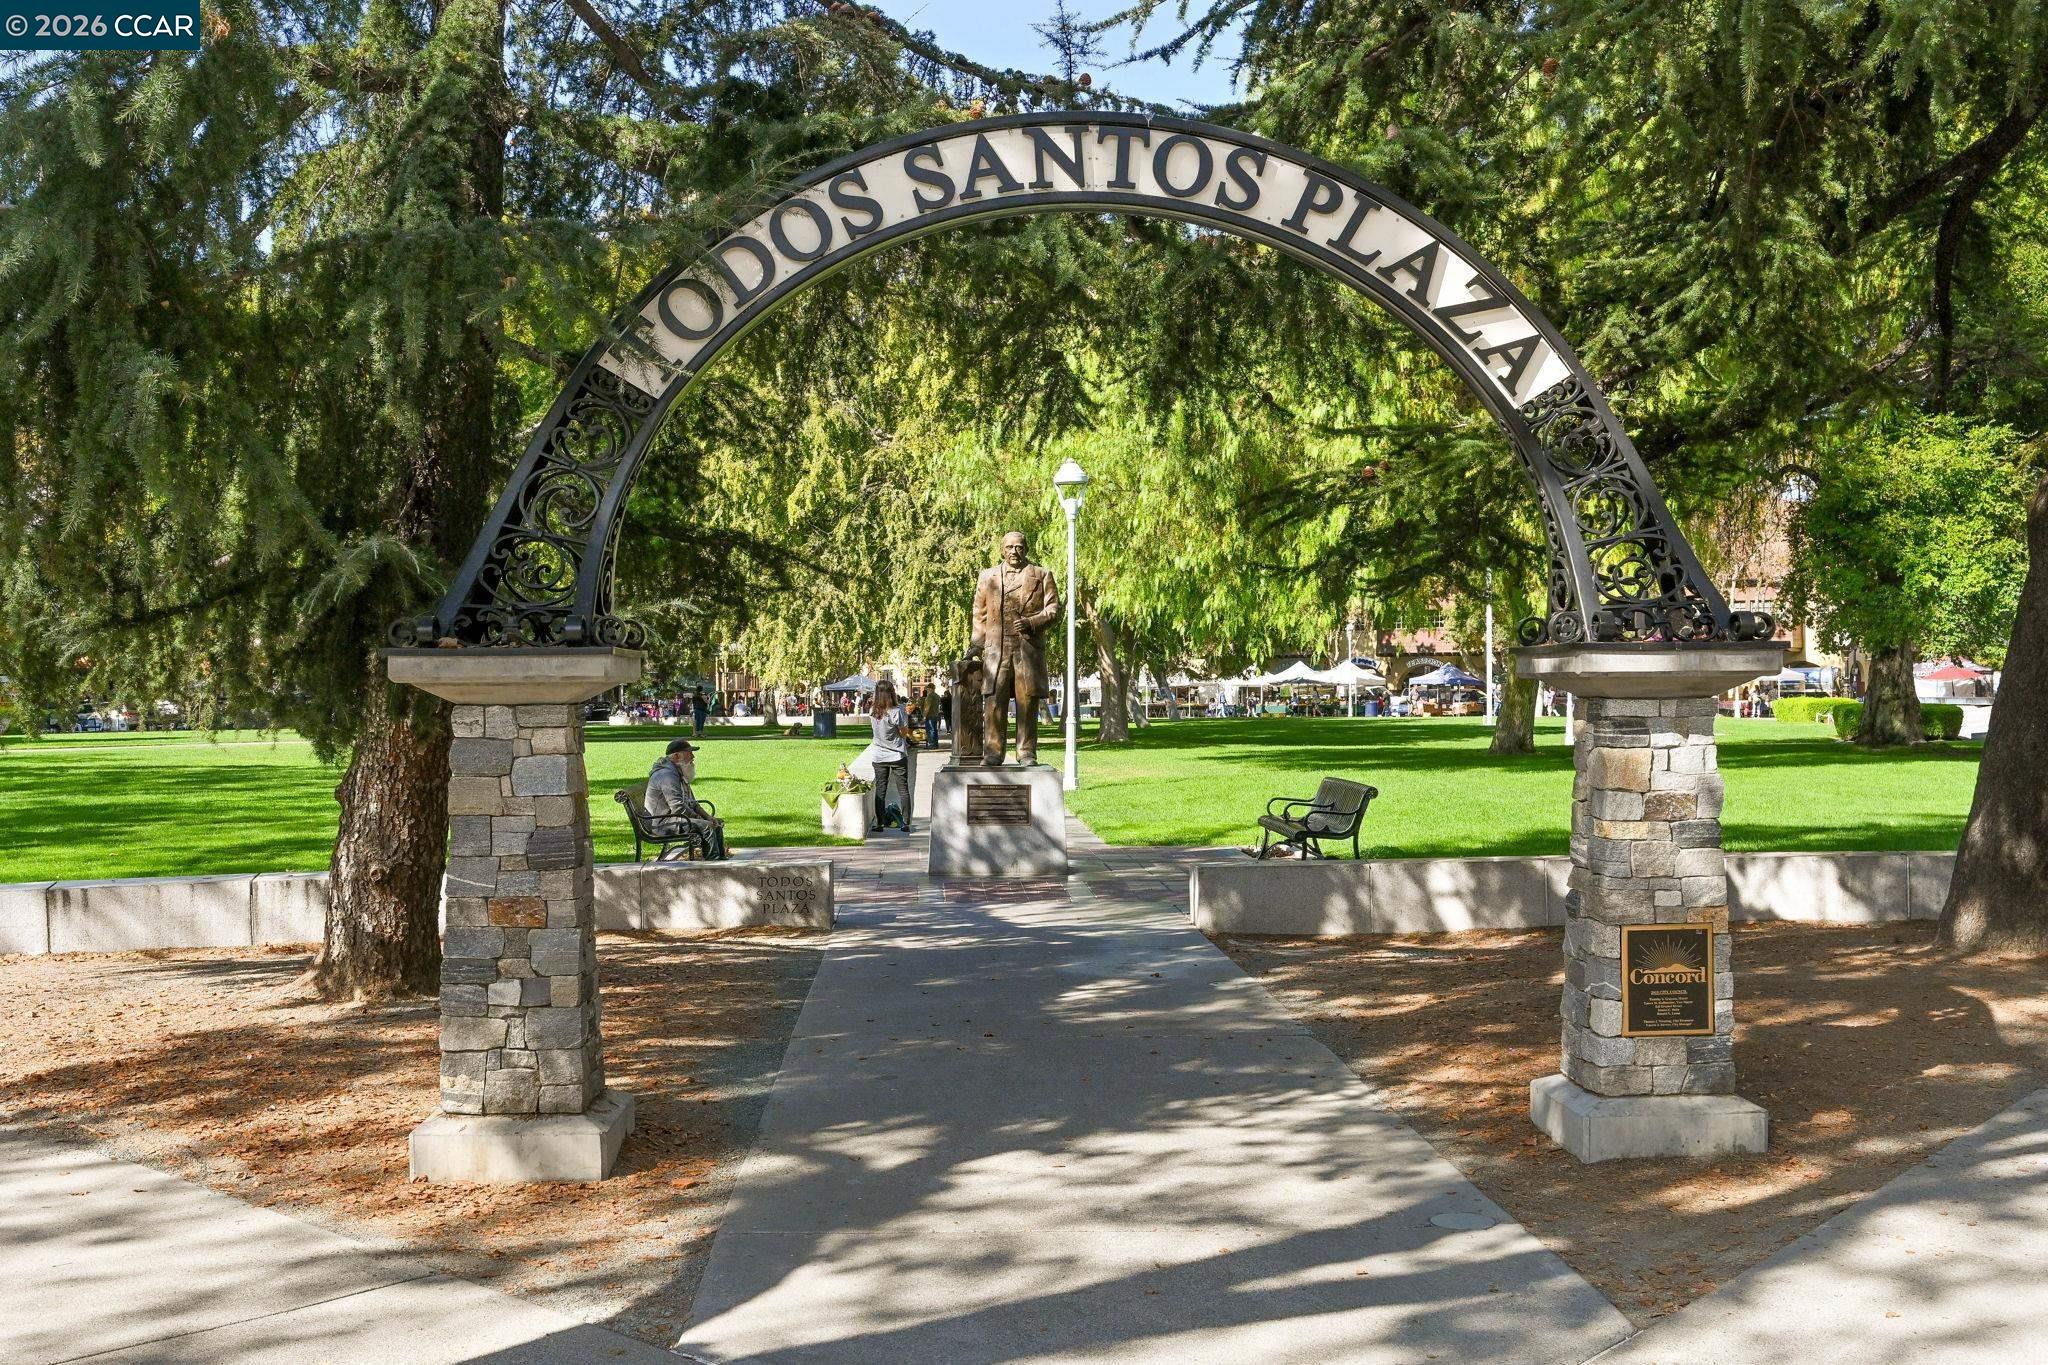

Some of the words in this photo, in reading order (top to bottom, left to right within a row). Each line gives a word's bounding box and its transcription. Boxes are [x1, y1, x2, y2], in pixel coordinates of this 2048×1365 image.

[607, 168, 884, 383] TODOS
[903, 126, 1269, 214] SANTOS
[1280, 168, 1543, 398] PLAZA
[757, 876, 813, 888] TODOS
[756, 889, 816, 901] SANTOS
[762, 903, 811, 914] PLAZA
[1629, 966, 1707, 985] Concord
